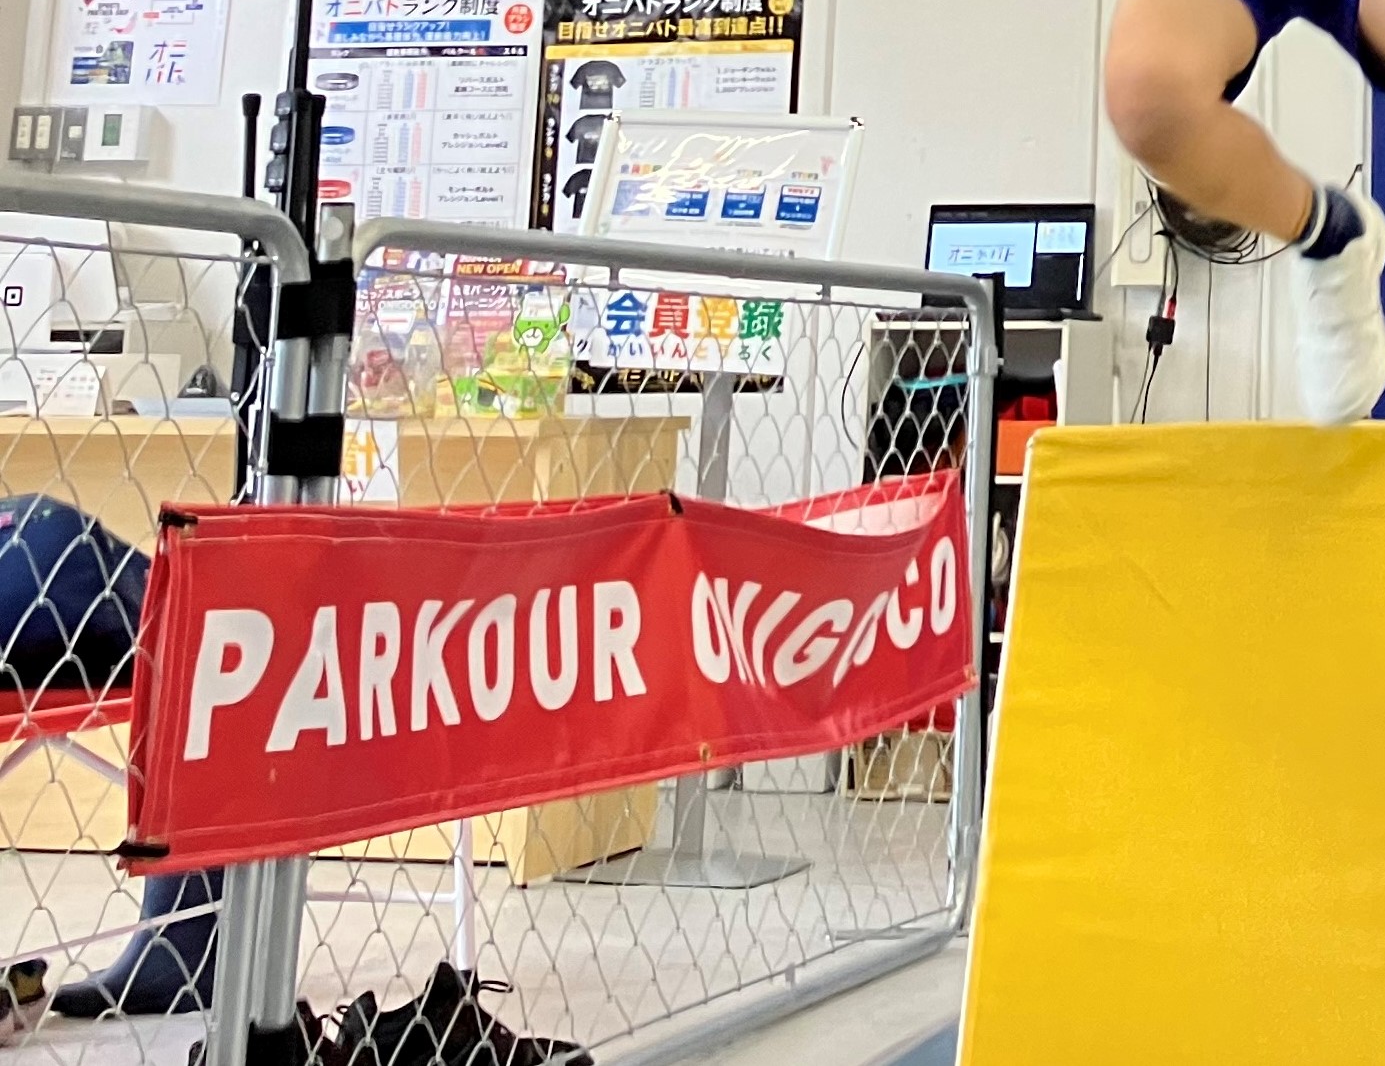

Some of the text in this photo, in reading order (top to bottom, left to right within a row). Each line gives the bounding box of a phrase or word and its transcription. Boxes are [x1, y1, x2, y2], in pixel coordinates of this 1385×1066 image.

[457, 260, 522, 274] NEW OPEN
[606, 292, 784, 340] 会員登録
[183, 580, 647, 762] PARKOUR
